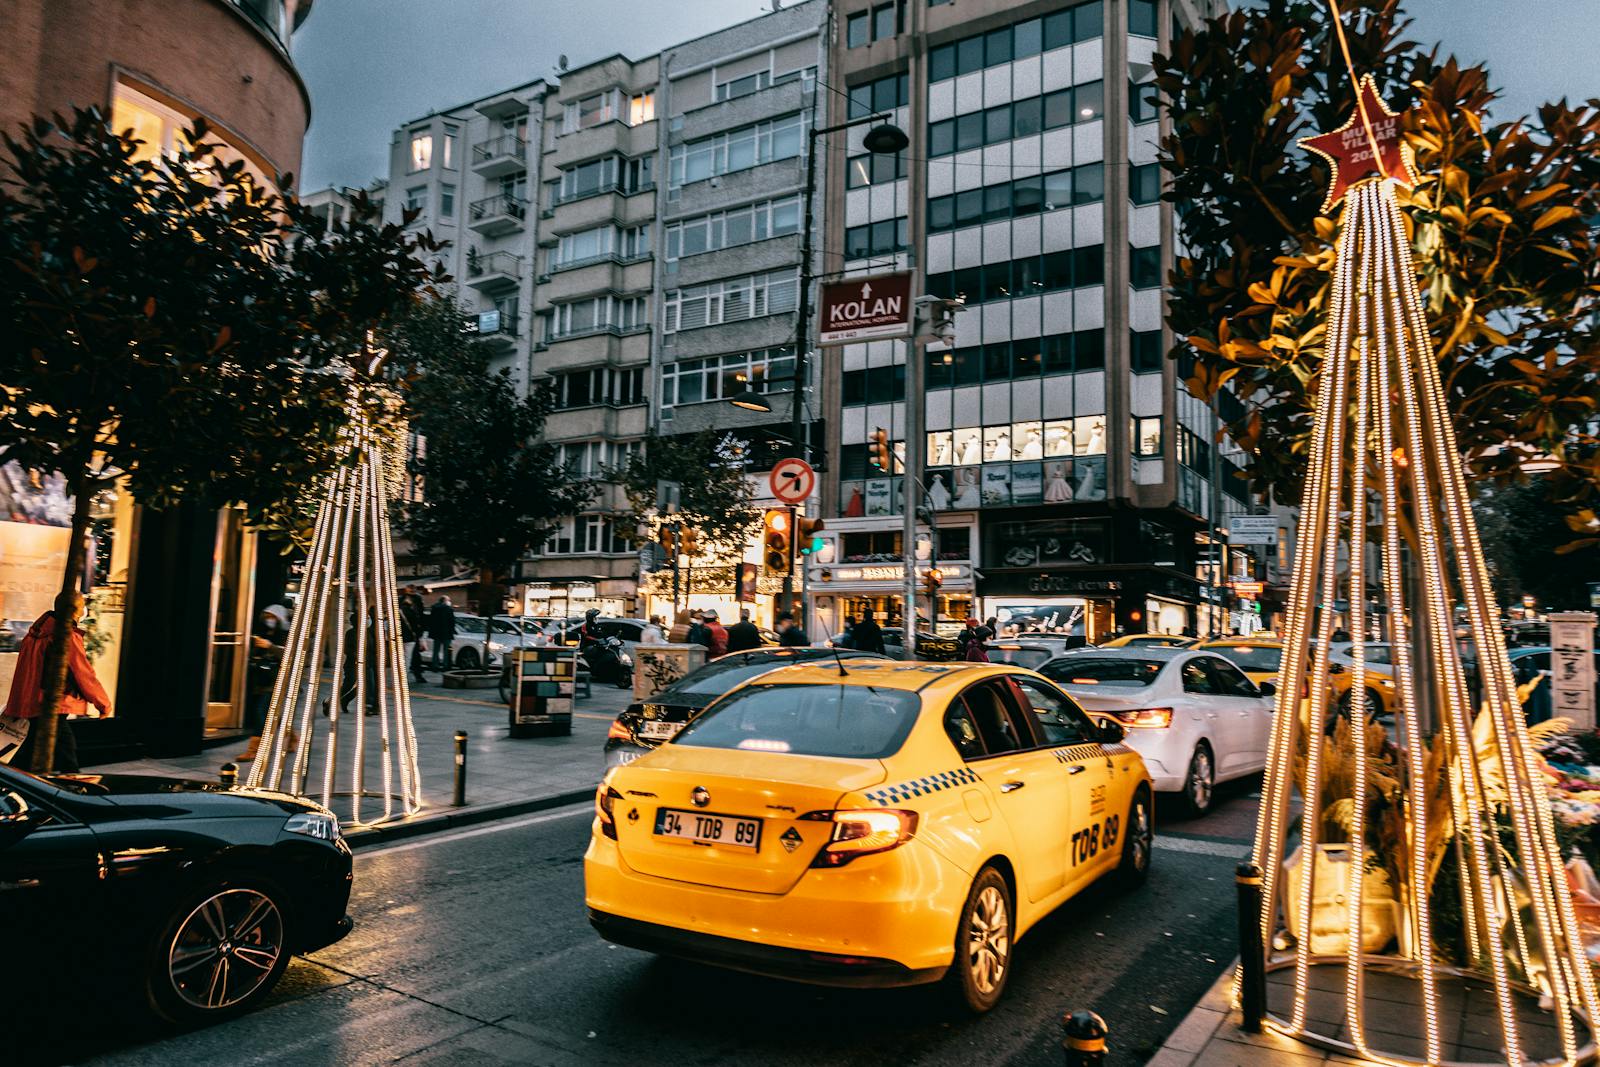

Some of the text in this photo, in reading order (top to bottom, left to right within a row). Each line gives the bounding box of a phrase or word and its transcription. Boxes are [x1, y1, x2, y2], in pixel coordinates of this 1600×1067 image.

[1342, 118, 1396, 140] MULU
[830, 296, 901, 322] KOLAN
[830, 319, 872, 329] INTERNATIONAL
[664, 814, 755, 844] 34 TDB 89
